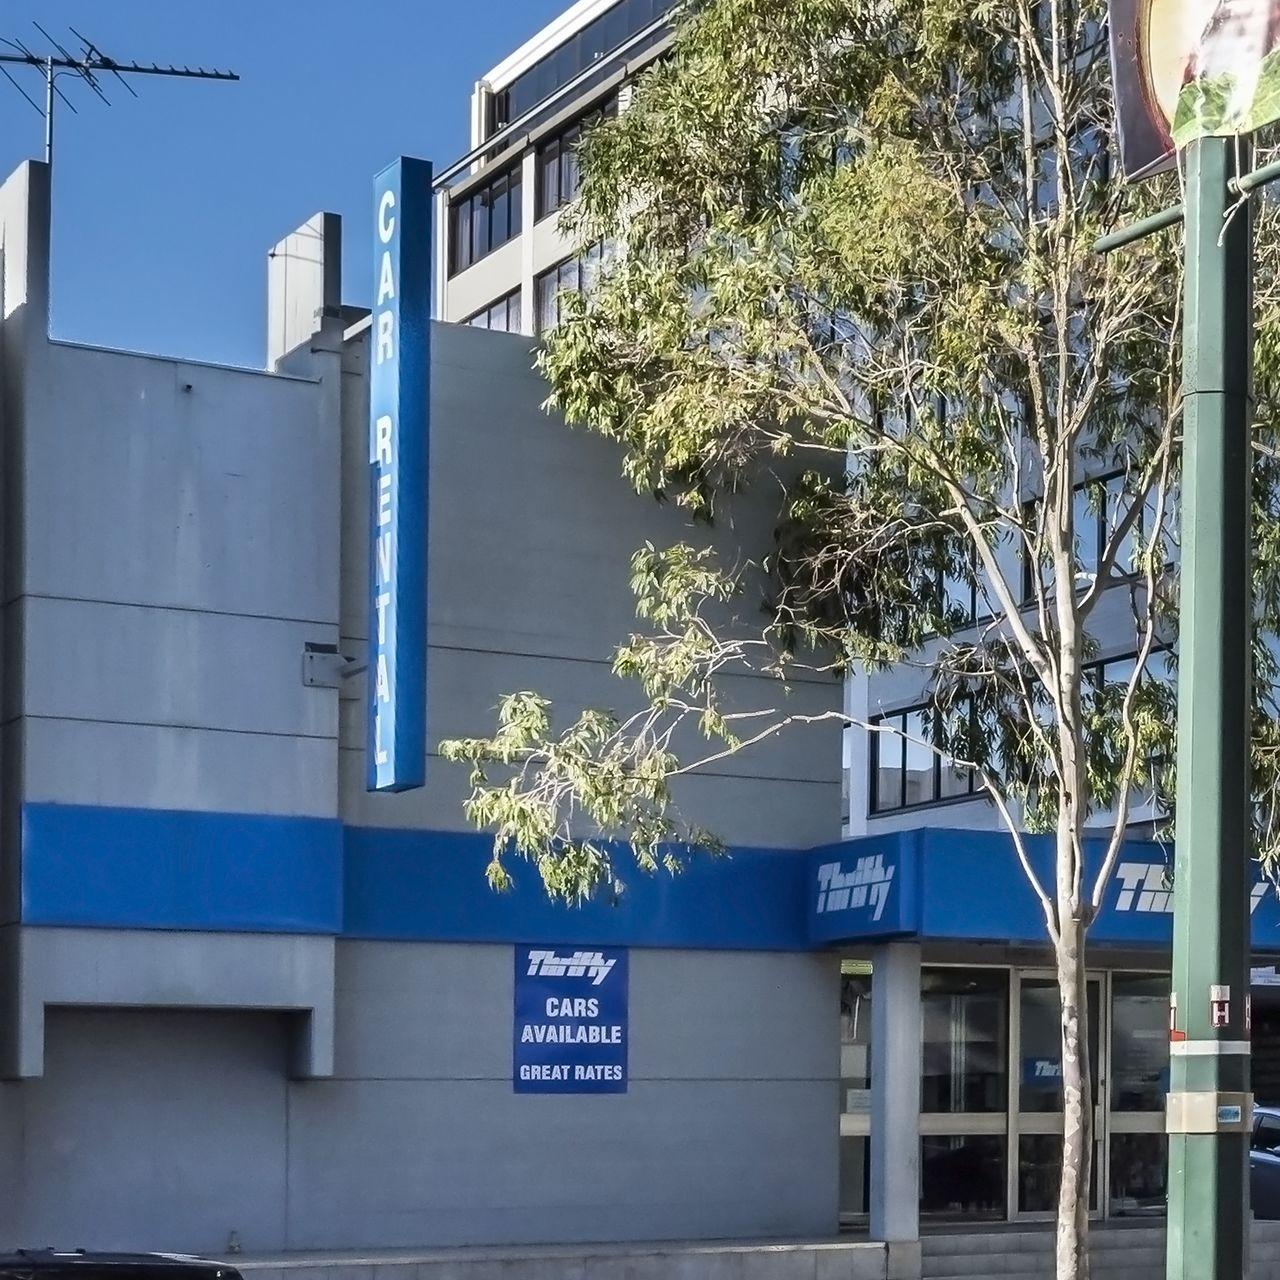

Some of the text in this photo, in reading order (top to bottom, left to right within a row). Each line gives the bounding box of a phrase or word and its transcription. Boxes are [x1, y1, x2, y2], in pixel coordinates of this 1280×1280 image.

[375, 189, 396, 766] CAR RENTAL
[816, 854, 896, 921] Thrifty
[527, 950, 617, 986] Thrifty
[546, 997, 599, 1018] CARS
[521, 1024, 622, 1044] AVAILABLE
[520, 1065, 623, 1081] GREAT RATES
